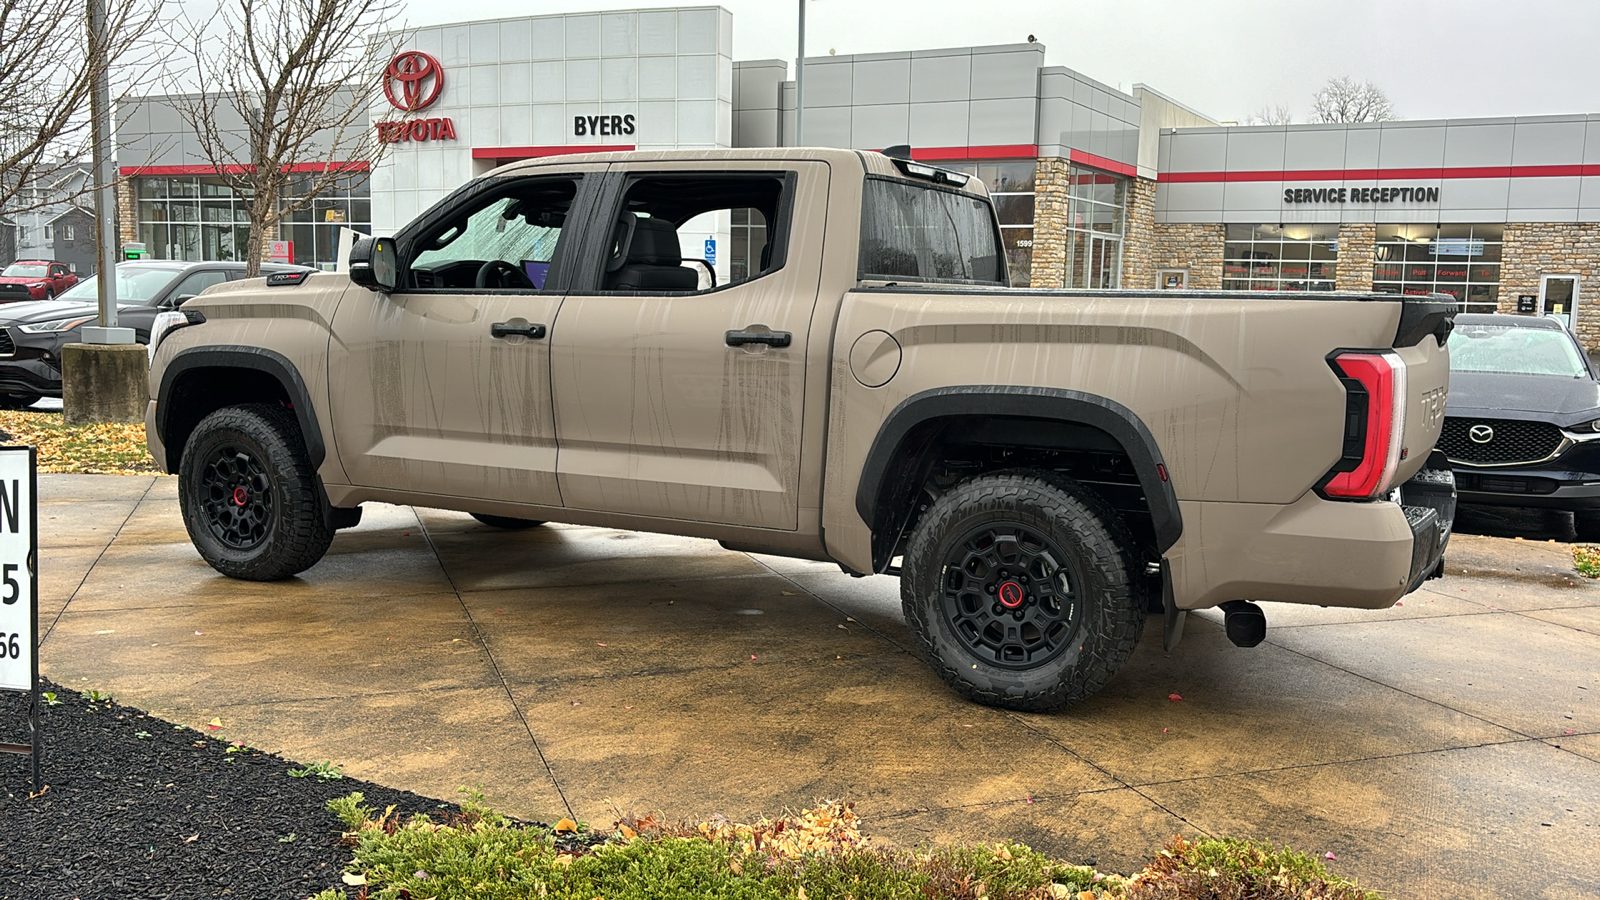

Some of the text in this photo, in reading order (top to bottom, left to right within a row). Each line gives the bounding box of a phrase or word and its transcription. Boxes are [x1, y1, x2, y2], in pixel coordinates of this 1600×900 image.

[374, 118, 456, 143] TOYOTA
[574, 114, 635, 136] BYERS
[1284, 187, 1439, 203] SERVICE RECEPTION
[1016, 240, 1033, 248] 1599
[0, 479, 19, 534] N
[2, 563, 20, 605] 5
